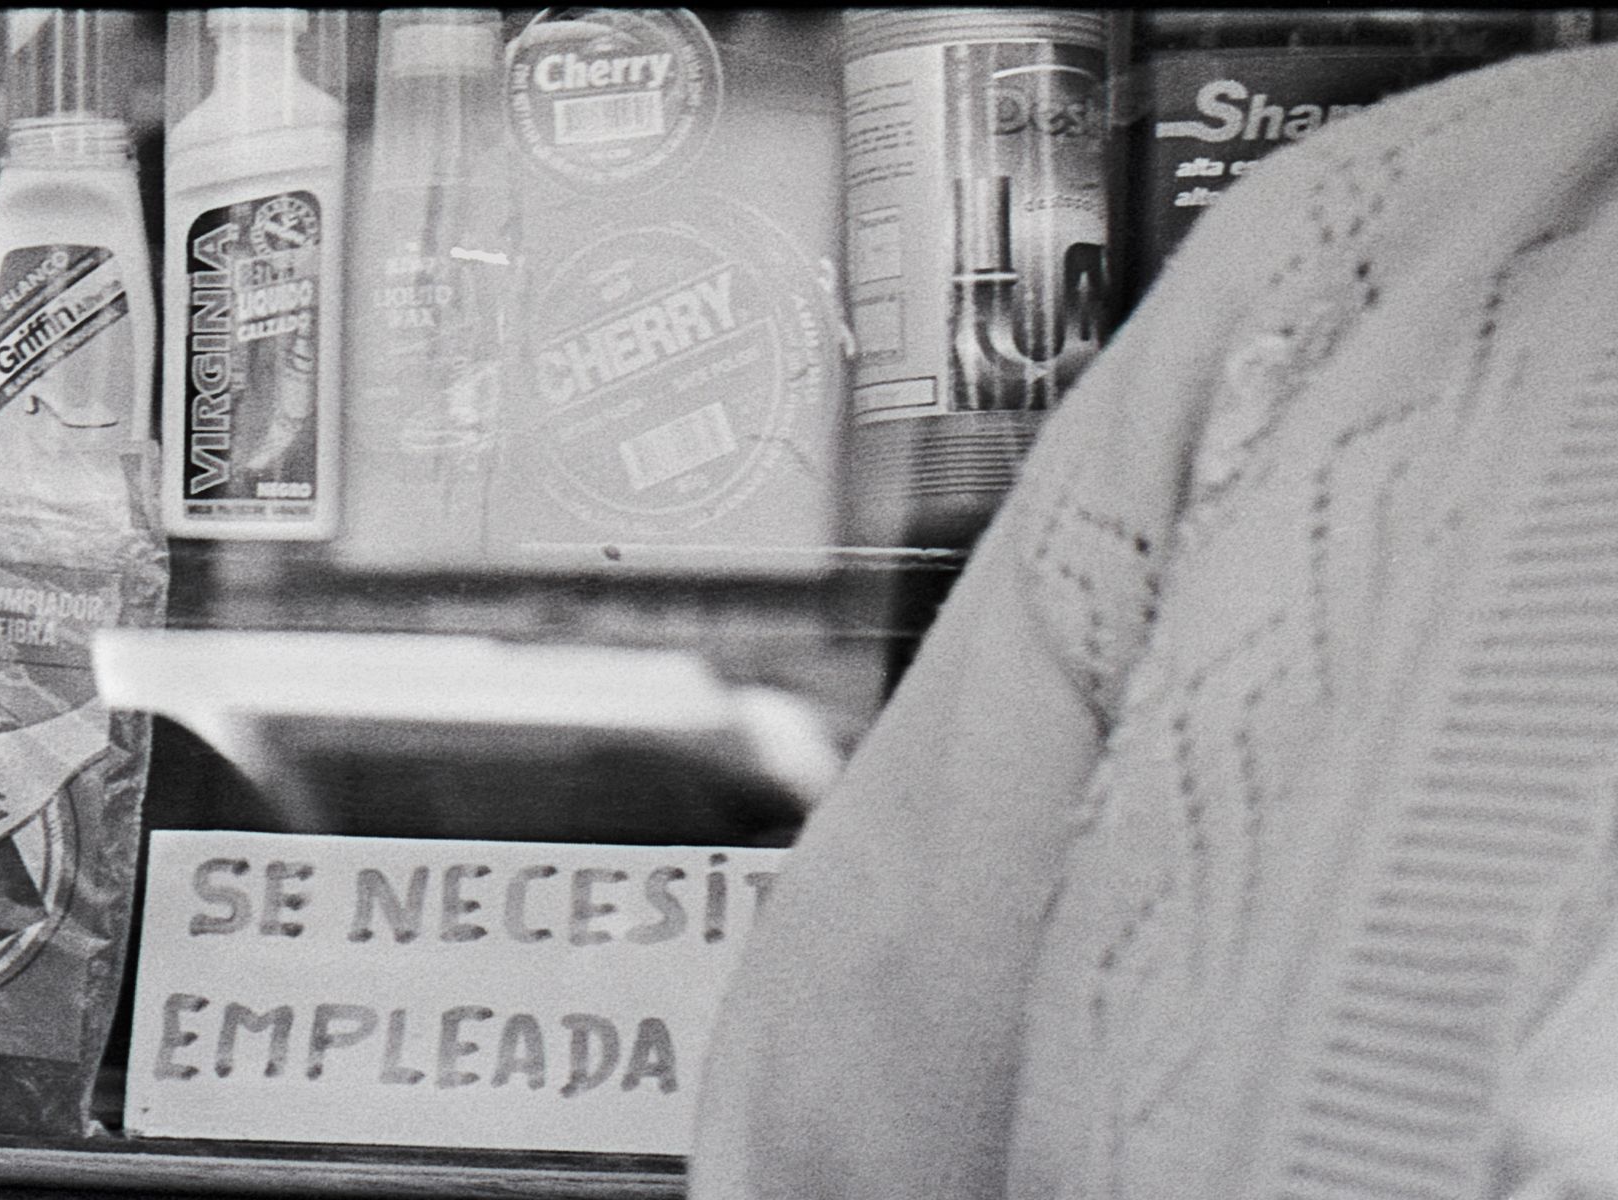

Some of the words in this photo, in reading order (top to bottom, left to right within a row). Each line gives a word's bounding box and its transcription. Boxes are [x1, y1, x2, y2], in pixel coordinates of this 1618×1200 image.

[533, 52, 674, 92] Cherry
[0, 249, 71, 310] BLANCO
[189, 220, 241, 495] VIRGINIA
[536, 270, 741, 407] CHERRY
[255, 481, 313, 499] NEGRO
[187, 857, 315, 939] SE
[154, 993, 680, 1099] EMPLEADA
